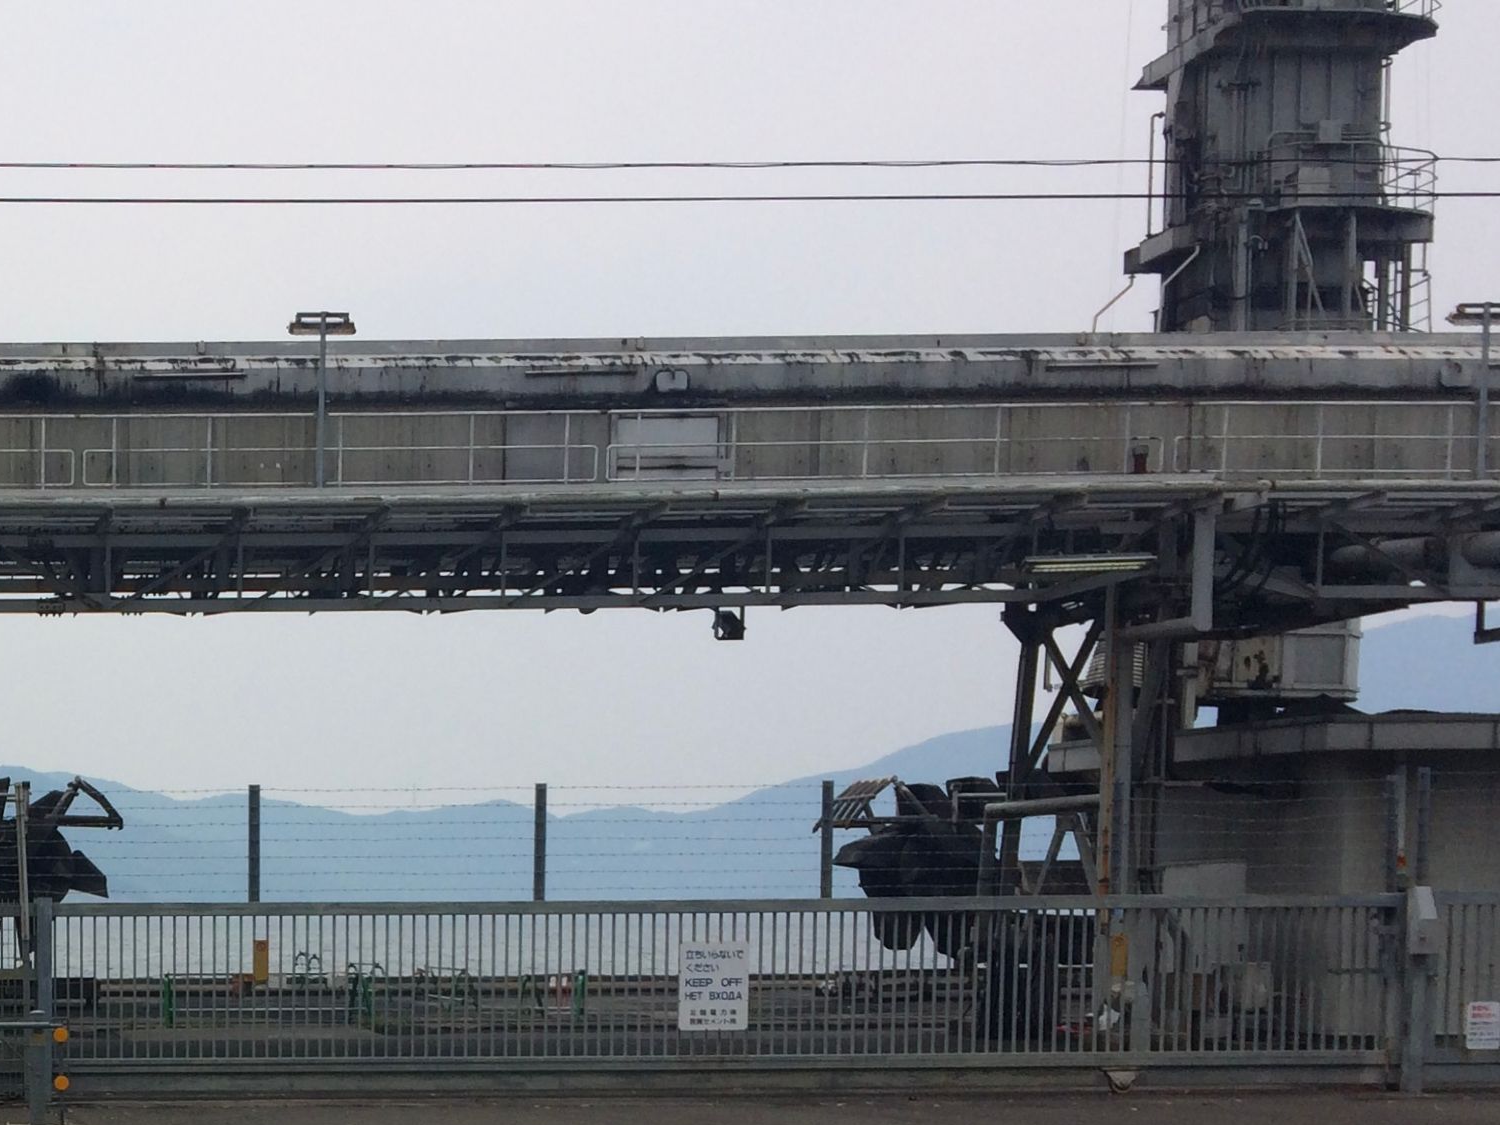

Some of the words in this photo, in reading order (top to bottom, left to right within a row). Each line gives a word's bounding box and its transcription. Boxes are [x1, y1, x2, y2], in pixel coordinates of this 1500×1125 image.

[686, 963, 720, 973] ください
[684, 978, 713, 988] KEEP
[721, 978, 743, 988] OFF
[684, 991, 703, 1000] НЕТ
[708, 991, 743, 1000] ВХОДА
